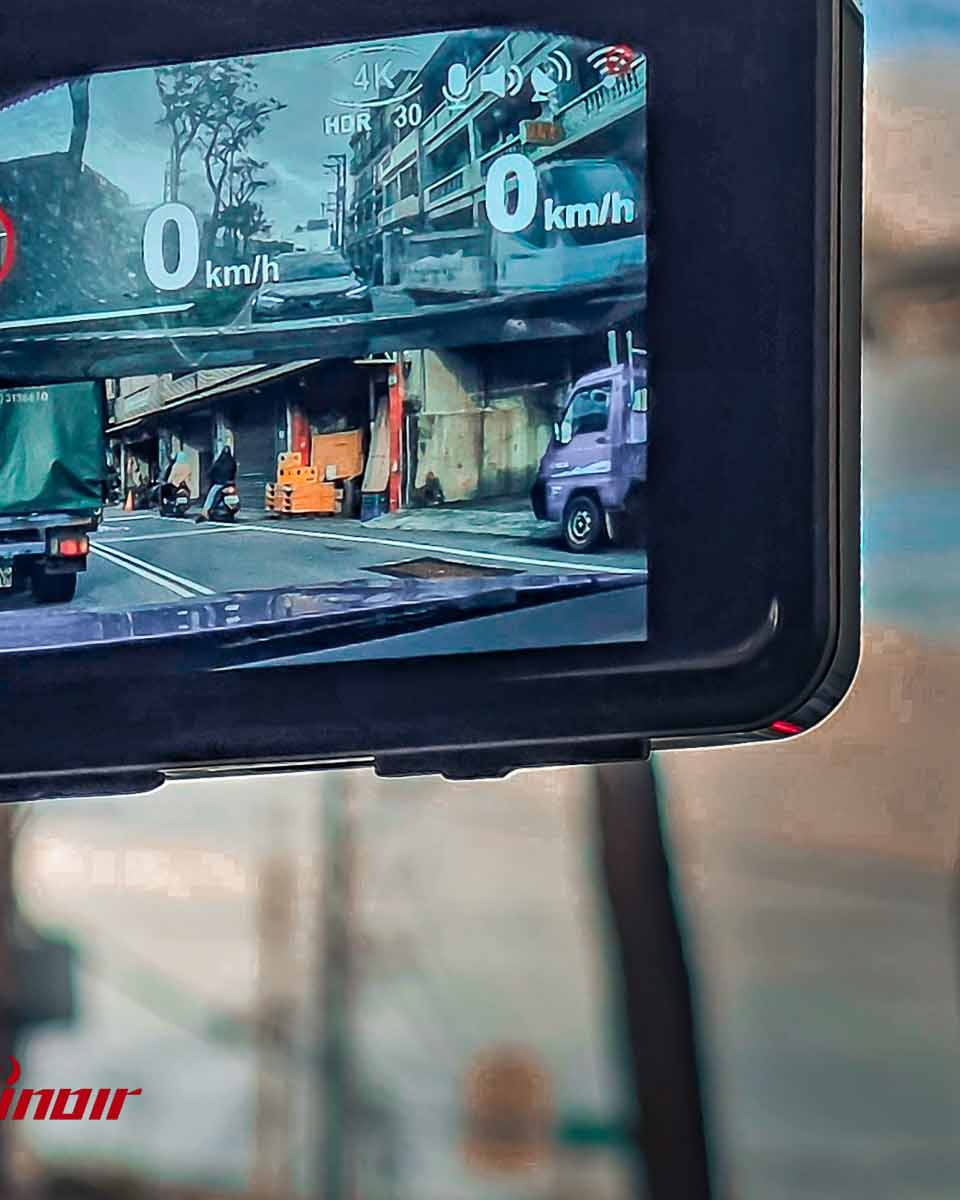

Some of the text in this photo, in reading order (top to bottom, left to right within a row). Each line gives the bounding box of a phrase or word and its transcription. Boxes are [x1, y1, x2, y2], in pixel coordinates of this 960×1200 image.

[353, 60, 395, 92] 4K
[324, 111, 373, 135] HDR
[393, 103, 423, 129] 30
[486, 153, 635, 233] 0 km/h
[143, 201, 280, 291] 0 km/h
